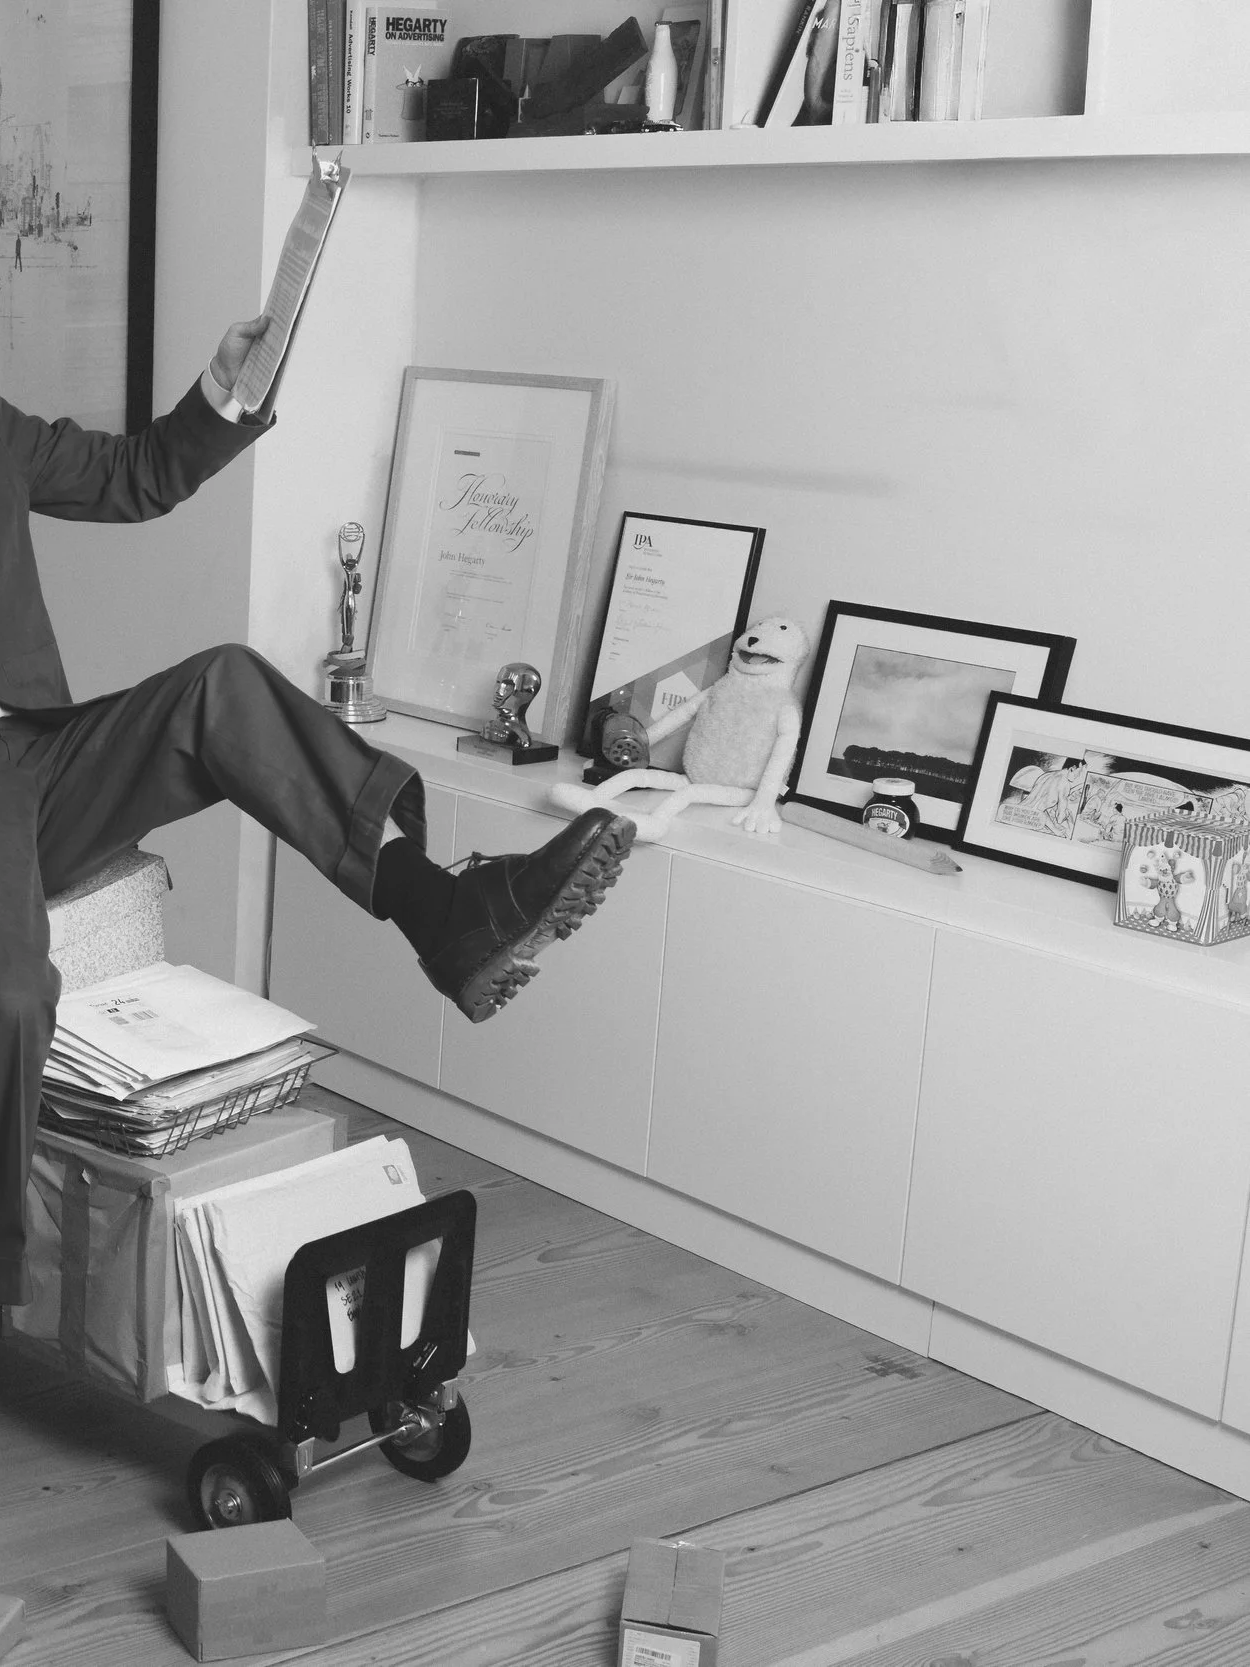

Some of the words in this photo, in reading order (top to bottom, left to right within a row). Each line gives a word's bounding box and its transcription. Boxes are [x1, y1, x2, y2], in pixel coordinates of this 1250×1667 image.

[385, 17, 447, 33] HEGARTY
[369, 16, 377, 56] HEGARTY
[385, 32, 396, 40] ON
[397, 32, 445, 42] ADVERTISING
[346, 34, 354, 76] Advertising
[842, 16, 861, 81] Sapiens
[346, 105, 351, 114] 10
[439, 473, 519, 515] Honorary
[452, 507, 534, 553] Fellowship
[633, 534, 653, 550] IPA
[438, 550, 456, 562] John
[457, 552, 485, 566] Hegarty
[871, 807, 898, 820] HEGARTY
[111, 998, 126, 1006] 24
